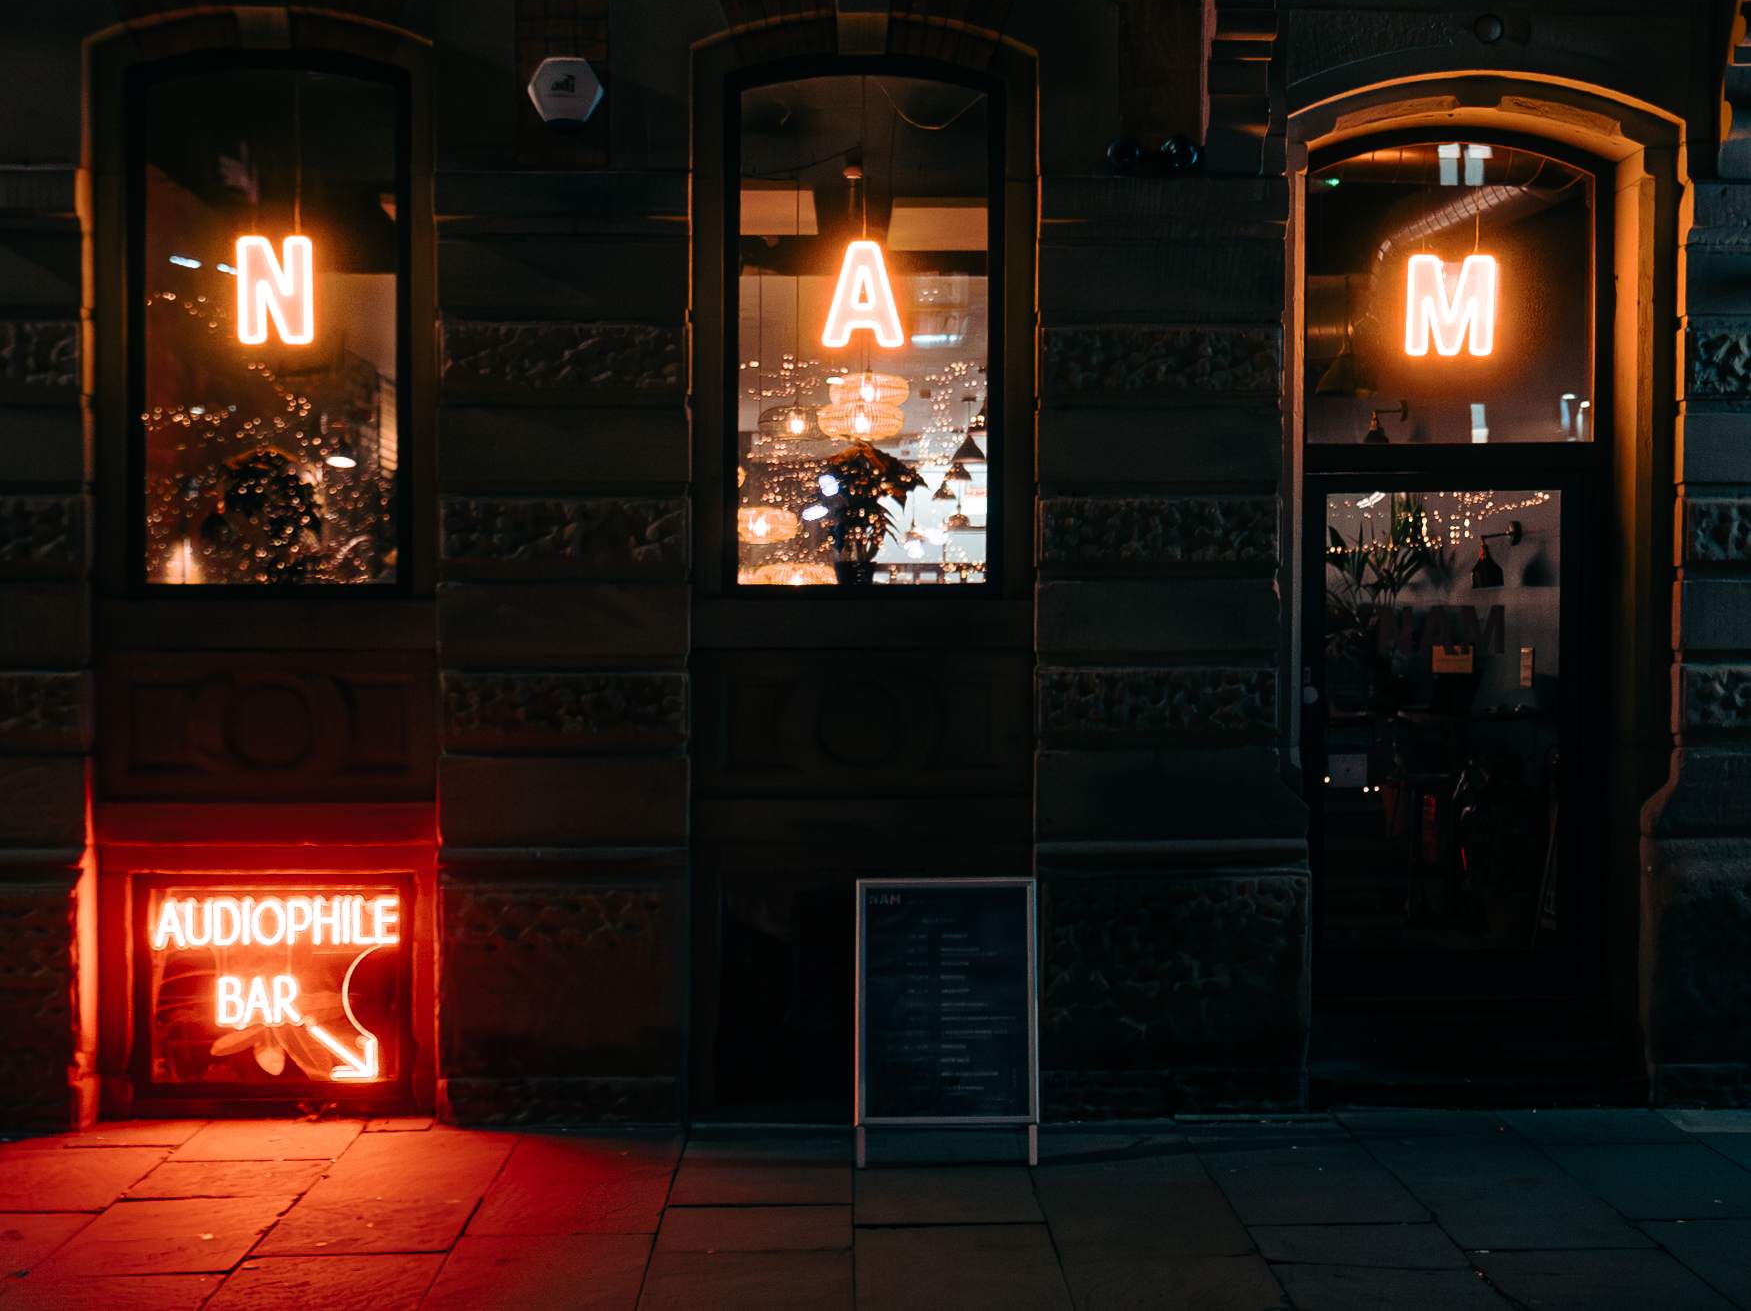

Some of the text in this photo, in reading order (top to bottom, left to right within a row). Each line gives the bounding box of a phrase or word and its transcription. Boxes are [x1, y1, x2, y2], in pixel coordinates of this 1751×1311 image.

[235, 235, 1496, 357] N A M
[151, 894, 400, 951] AUDIOPHILE
[215, 974, 306, 1029] BAR
